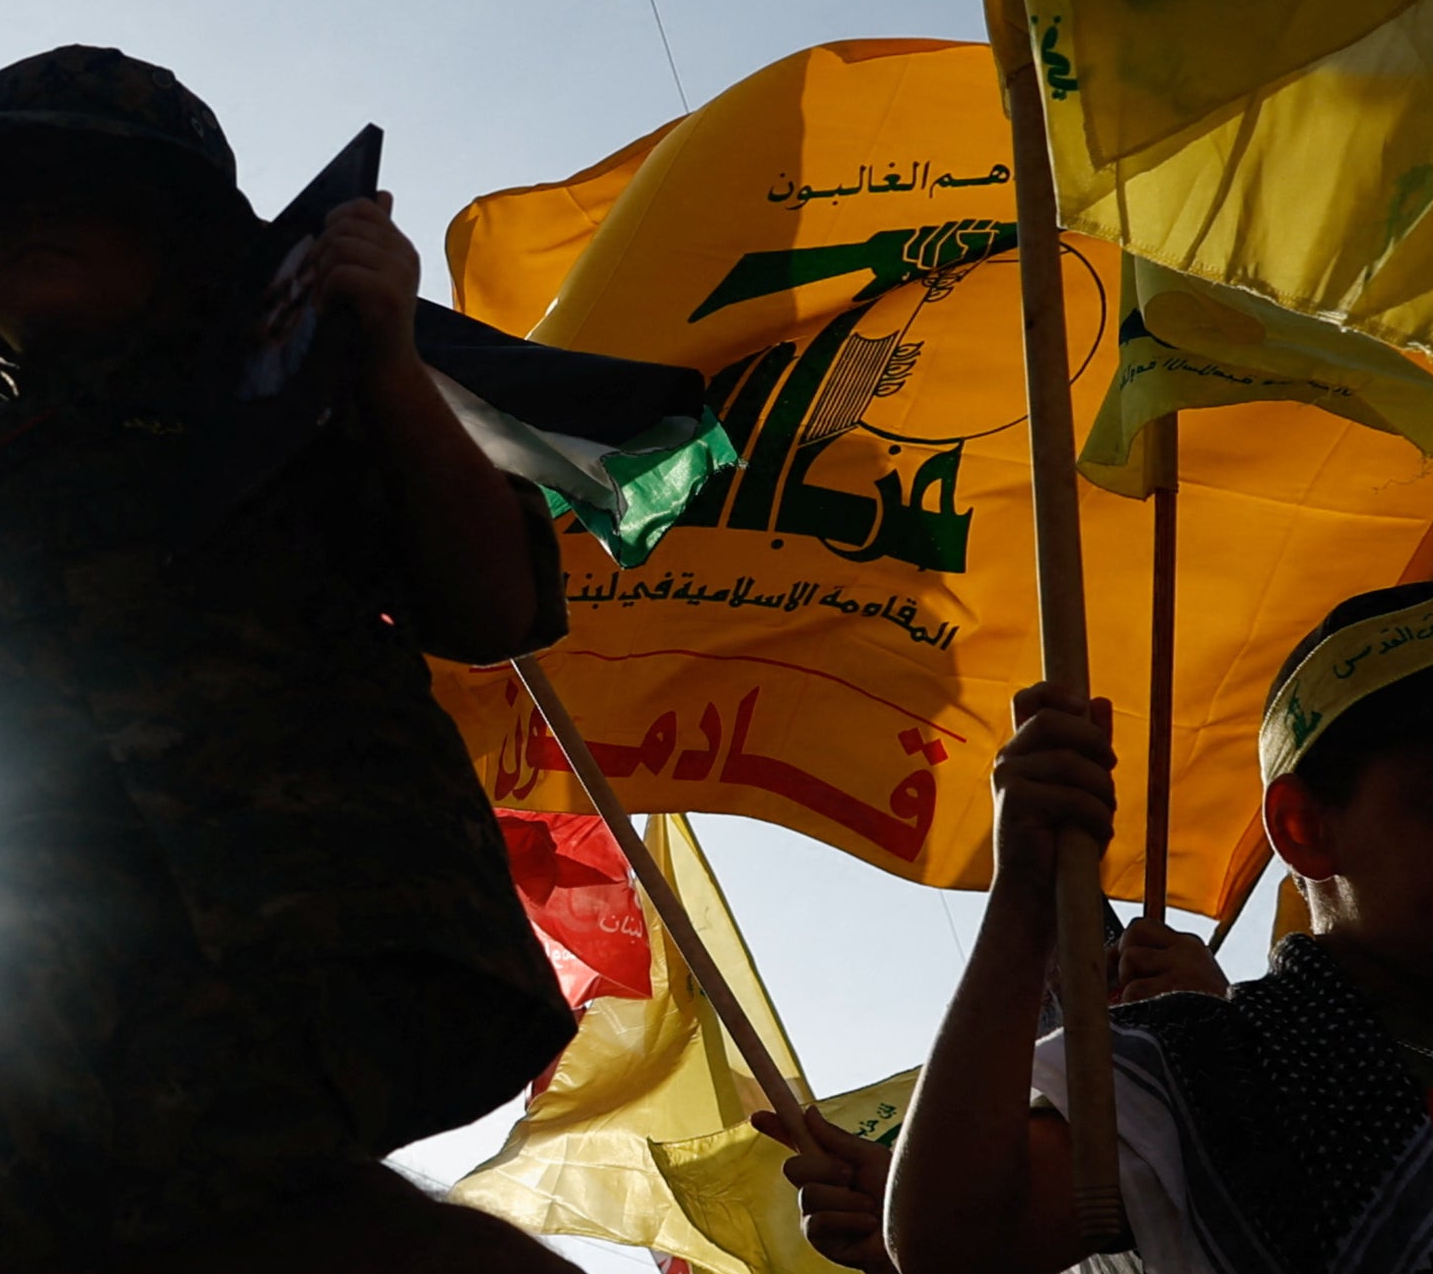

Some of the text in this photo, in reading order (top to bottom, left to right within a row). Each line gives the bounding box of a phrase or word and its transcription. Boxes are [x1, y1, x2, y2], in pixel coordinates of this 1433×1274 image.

[767, 160, 931, 210] الغالبون
[562, 570, 620, 609] لبنا
[820, 582, 960, 652] المقاومة
